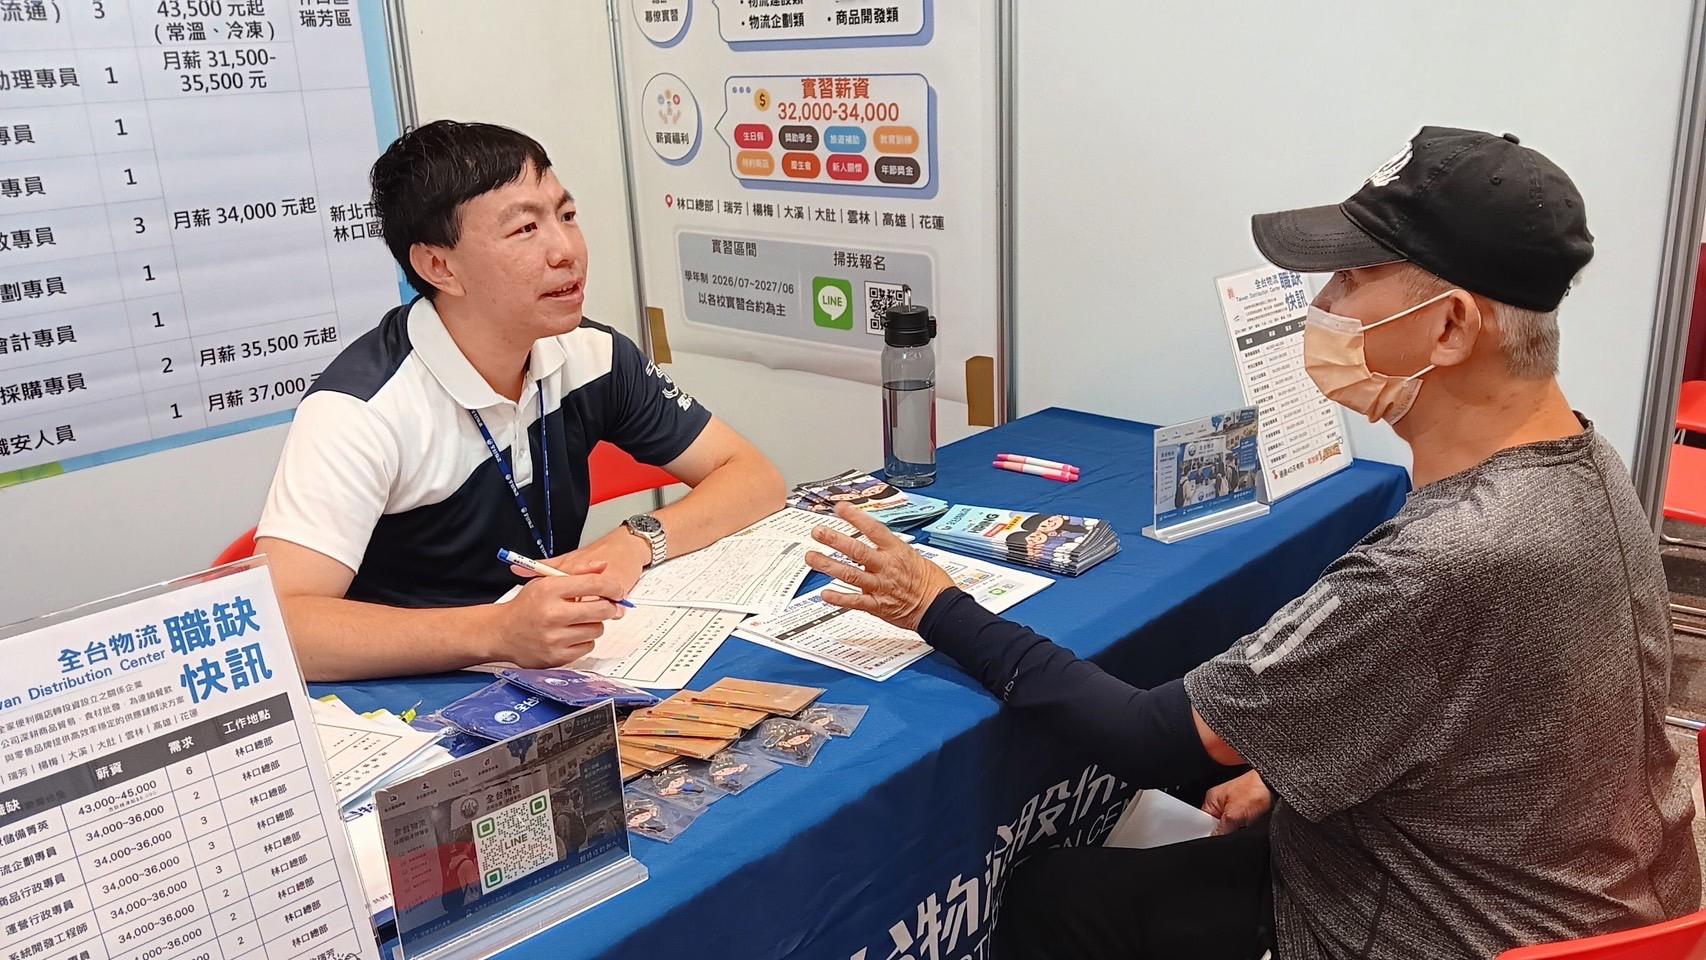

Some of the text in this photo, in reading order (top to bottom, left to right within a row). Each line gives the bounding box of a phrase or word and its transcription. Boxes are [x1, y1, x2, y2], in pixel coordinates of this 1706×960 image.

[92, 0, 106, 19] 3
[157, 0, 265, 18] 43,500 元起
[299, 9, 352, 28] 瑞芳區
[836, 7, 899, 25] 商品開發類
[749, 12, 804, 29] 物流企劃類
[163, 49, 277, 71] 月薪 31,500-
[105, 67, 118, 85] 1
[180, 71, 267, 93] 35,500 元
[801, 78, 870, 99] 實習薪資
[778, 102, 899, 123] 32,000-34,000
[114, 119, 128, 136] 1
[125, 168, 137, 185] 1
[881, 165, 914, 177] 年節獎金
[0, 176, 46, 198] 專員
[173, 197, 317, 230] 月薪 34,000 元起
[330, 201, 375, 222] 新北市
[677, 198, 714, 212] 林口總部
[815, 208, 836, 222] 大肚
[847, 210, 870, 225] 雲林
[882, 212, 907, 227] 高雄
[919, 215, 945, 230] 花蓮
[135, 217, 146, 234] 3
[333, 221, 383, 242] 林口區
[712, 239, 757, 257] 實習區間
[834, 251, 886, 271] 掃我報名
[143, 265, 156, 281] 1
[712, 274, 795, 294] 2026/07~2027/06
[698, 292, 786, 317] 以各校實習合約為主
[822, 295, 843, 307] LINE
[152, 312, 165, 328] 1
[199, 326, 338, 367] 月薪 35,500 元起
[162, 358, 173, 374] 2
[0, 372, 87, 406] 採購專員
[208, 390, 244, 412] 月薪
[249, 377, 306, 402] 37,000
[170, 403, 183, 419] 1
[164, 595, 261, 656] 職缺
[57, 624, 162, 674] 全台物流
[28, 666, 112, 700] Distribution
[120, 648, 166, 671] Center
[180, 642, 273, 704] 快訊
[222, 708, 272, 735] 工作地點
[168, 736, 195, 754] 需求
[235, 736, 274, 757] 林口總部
[95, 761, 124, 781] 薪資
[185, 766, 193, 775] 6
[242, 760, 281, 781] 林口總部
[77, 780, 157, 816] 43,000~45,000
[193, 791, 200, 800] 2
[249, 784, 287, 806] 林口總部
[86, 805, 164, 842] 34,000~36,000
[201, 816, 208, 825] 3
[256, 808, 295, 831] 林口總部
[94, 830, 172, 868] 34,000~36,000
[208, 841, 215, 850] 3
[263, 831, 301, 854] 林口總部
[504, 833, 528, 850] LINE
[102, 856, 180, 895] 34,000~36,000
[216, 865, 223, 874] 3
[270, 854, 308, 877] 林口總部
[223, 889, 230, 898] 2
[277, 877, 315, 900] 林口總部
[110, 880, 188, 920] 34,000~36,000
[5, 899, 74, 936] 運營行政專員
[230, 912, 237, 921] 2
[284, 900, 321, 924] 林口總部
[118, 904, 195, 944] 34,000~36,000
[8, 922, 89, 960] 系統開發工程師
[238, 936, 244, 945] 2
[292, 924, 329, 948] 林口總部
